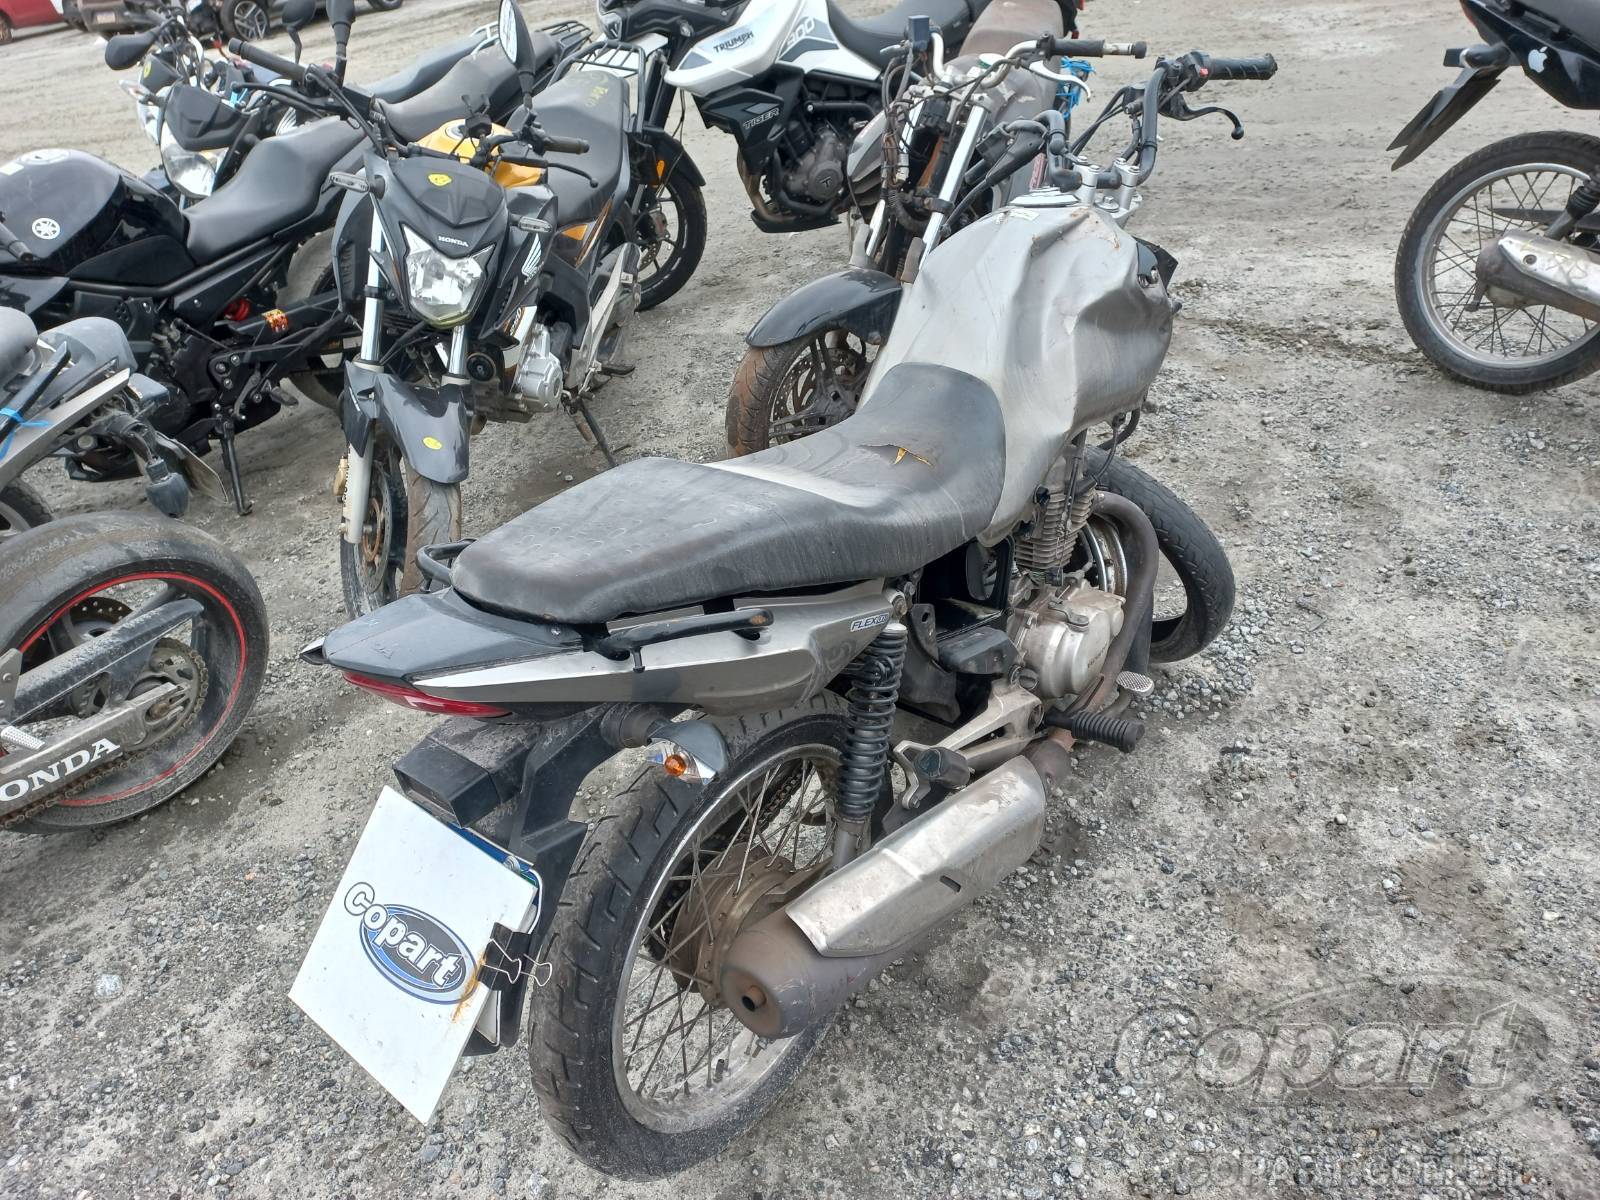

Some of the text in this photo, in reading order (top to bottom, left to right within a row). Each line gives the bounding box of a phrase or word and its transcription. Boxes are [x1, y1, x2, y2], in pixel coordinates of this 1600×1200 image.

[713, 31, 755, 53] TRIUMPH
[743, 107, 780, 130] TIGER
[438, 235, 469, 248] HONDA
[344, 881, 463, 988] Copart
